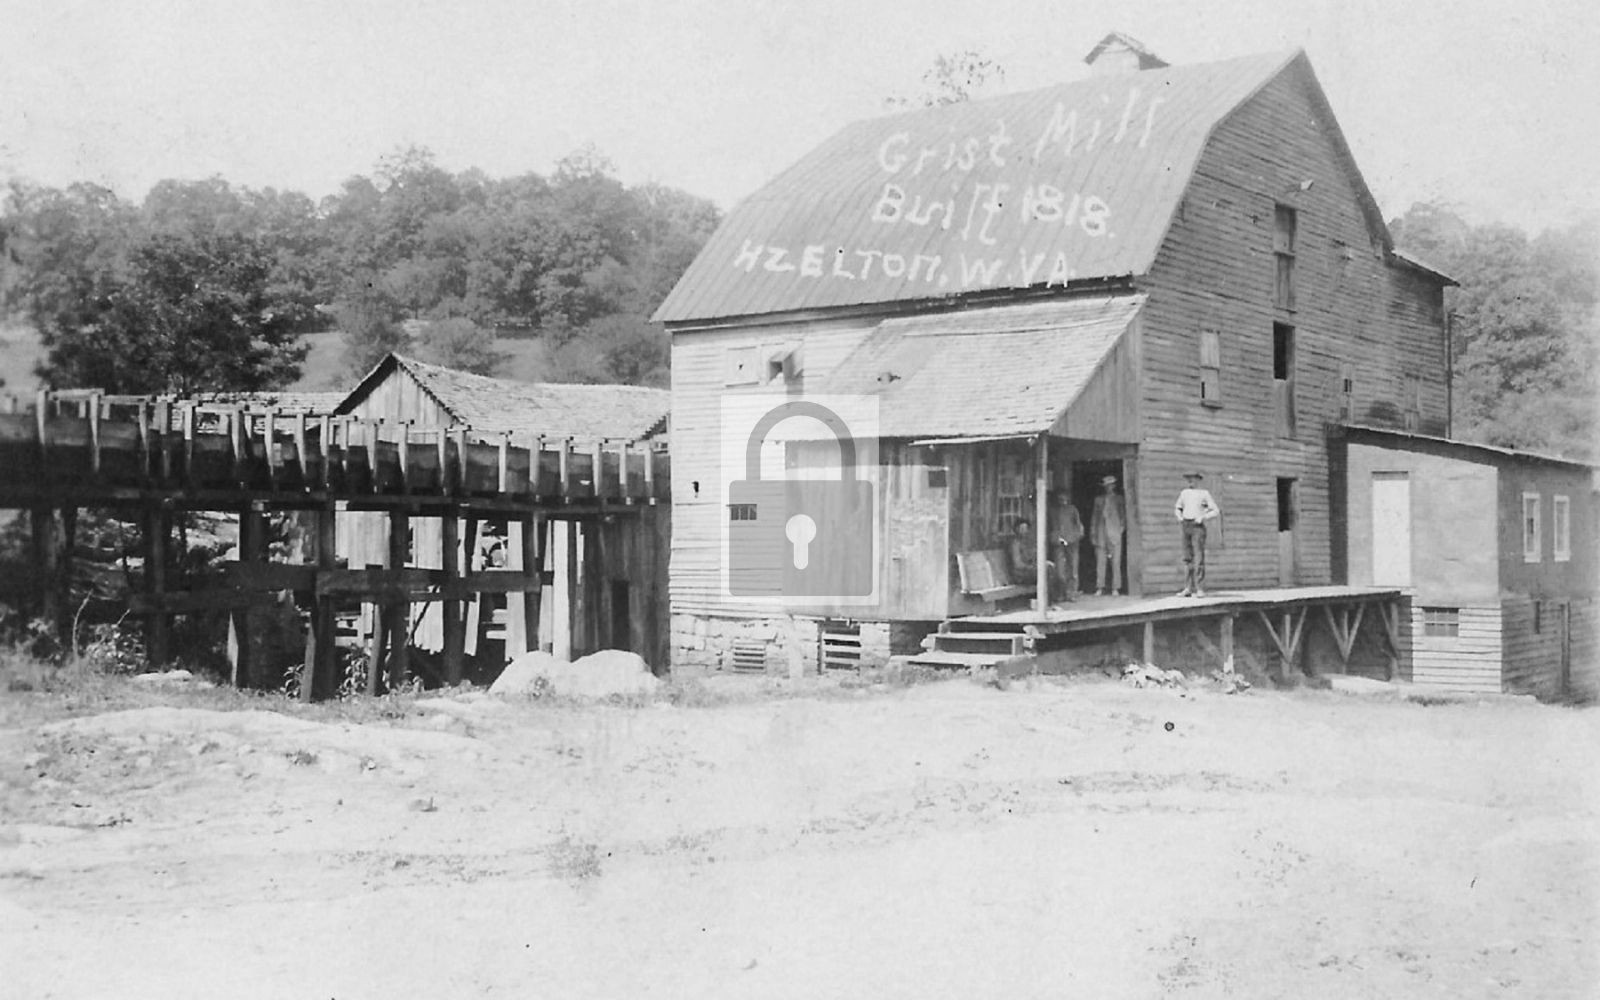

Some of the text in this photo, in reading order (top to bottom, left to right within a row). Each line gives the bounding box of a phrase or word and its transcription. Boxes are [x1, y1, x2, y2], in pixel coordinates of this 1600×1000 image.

[878, 87, 1166, 175] Grist Mill
[871, 182, 1010, 246] Built
